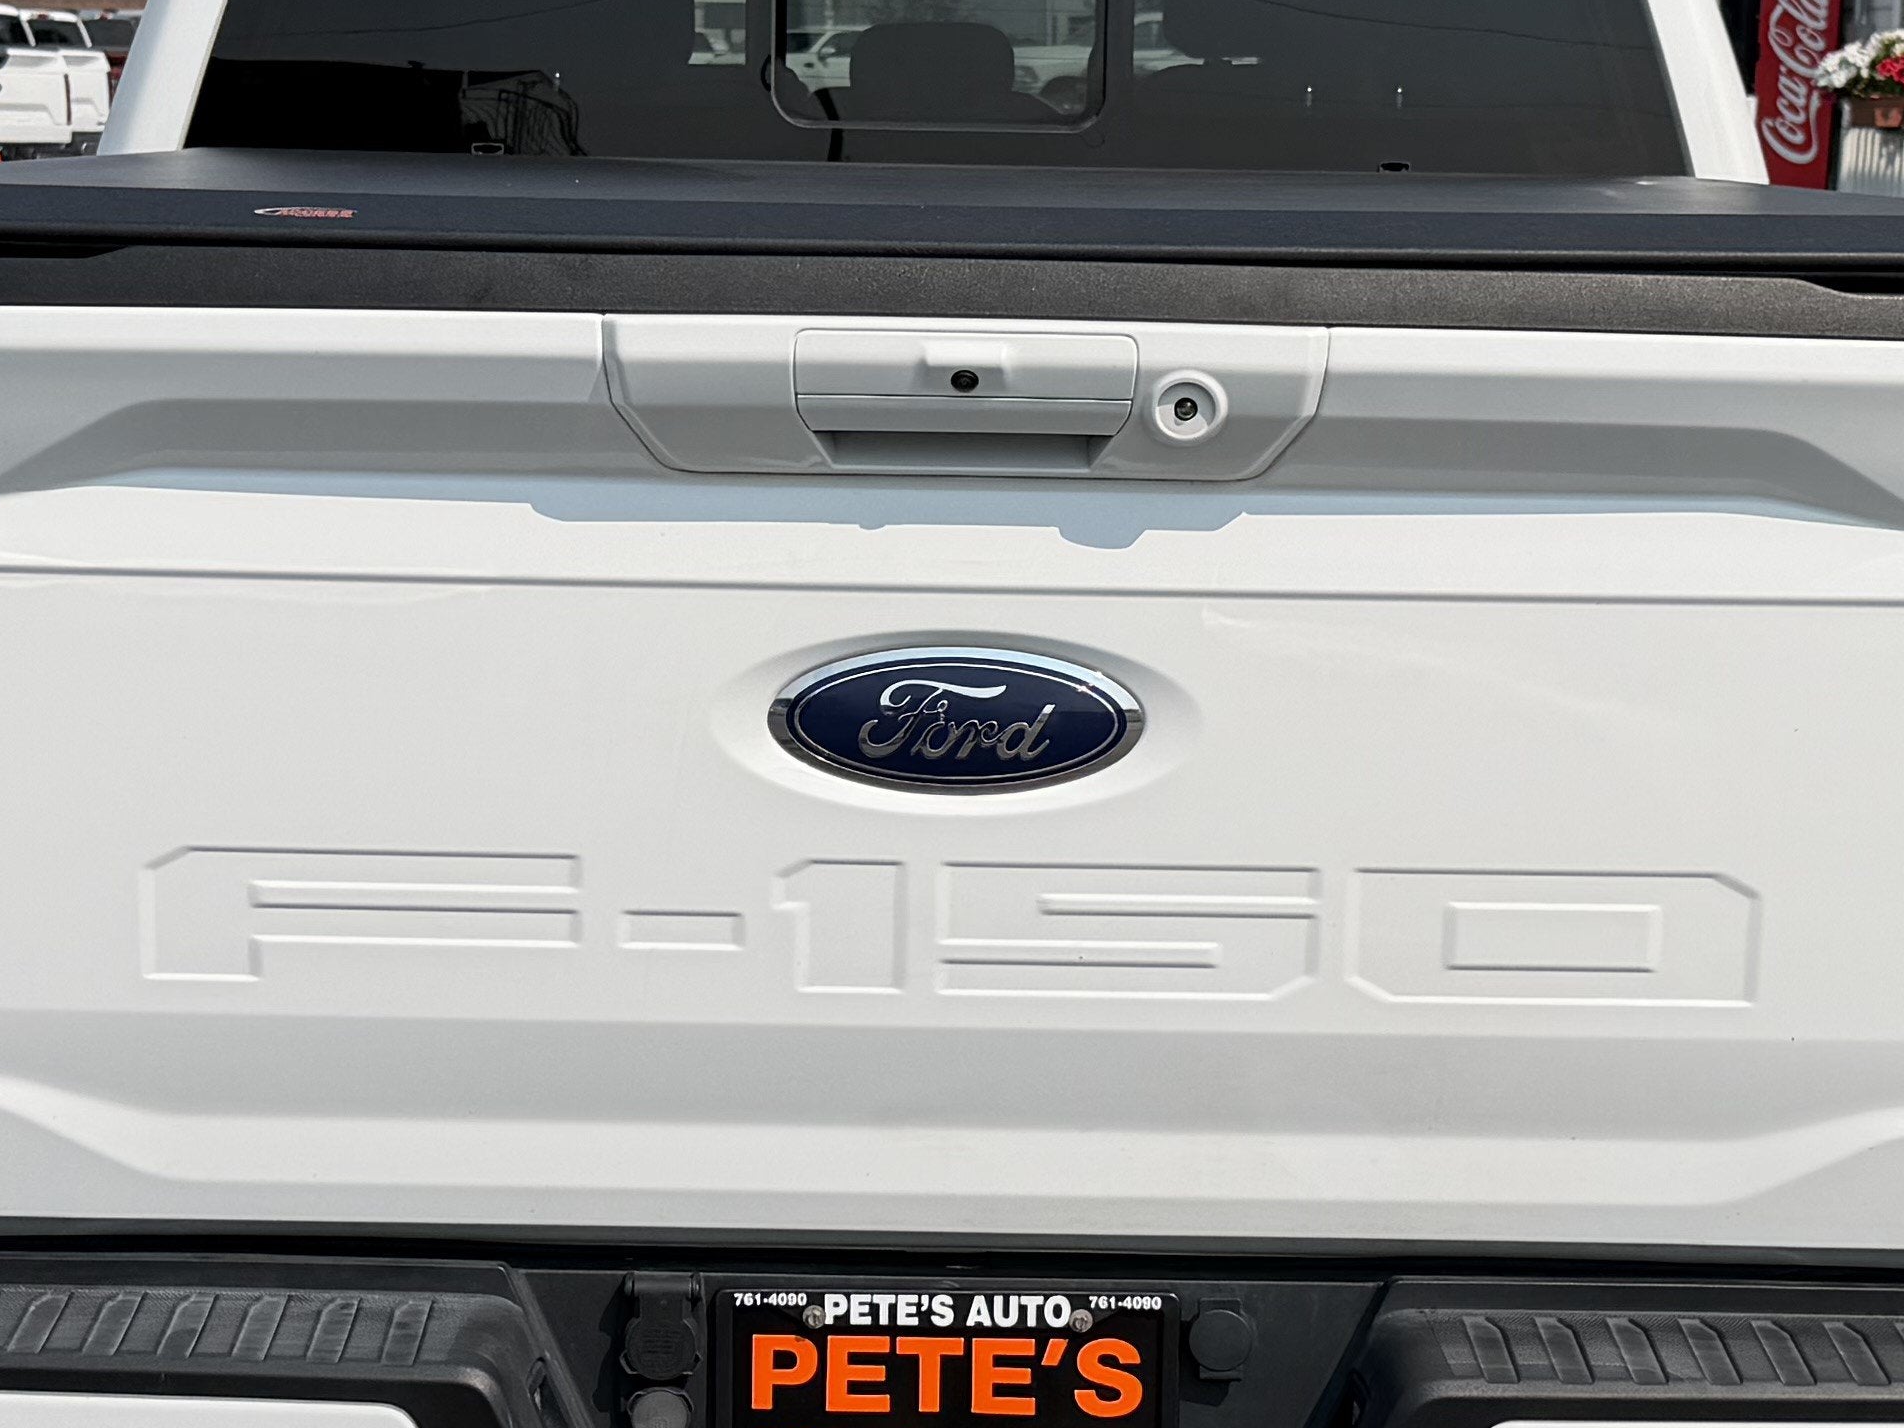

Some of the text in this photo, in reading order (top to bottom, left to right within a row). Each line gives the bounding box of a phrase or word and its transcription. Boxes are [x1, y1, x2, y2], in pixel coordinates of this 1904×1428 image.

[857, 678, 1056, 761] Ford
[142, 846, 1763, 1009] F-150
[733, 1291, 808, 1308] 761-4090
[823, 1292, 1073, 1329] PETE'S AUTO
[1088, 1294, 1163, 1311] 761-4090
[751, 1333, 1143, 1418] PETE'S
